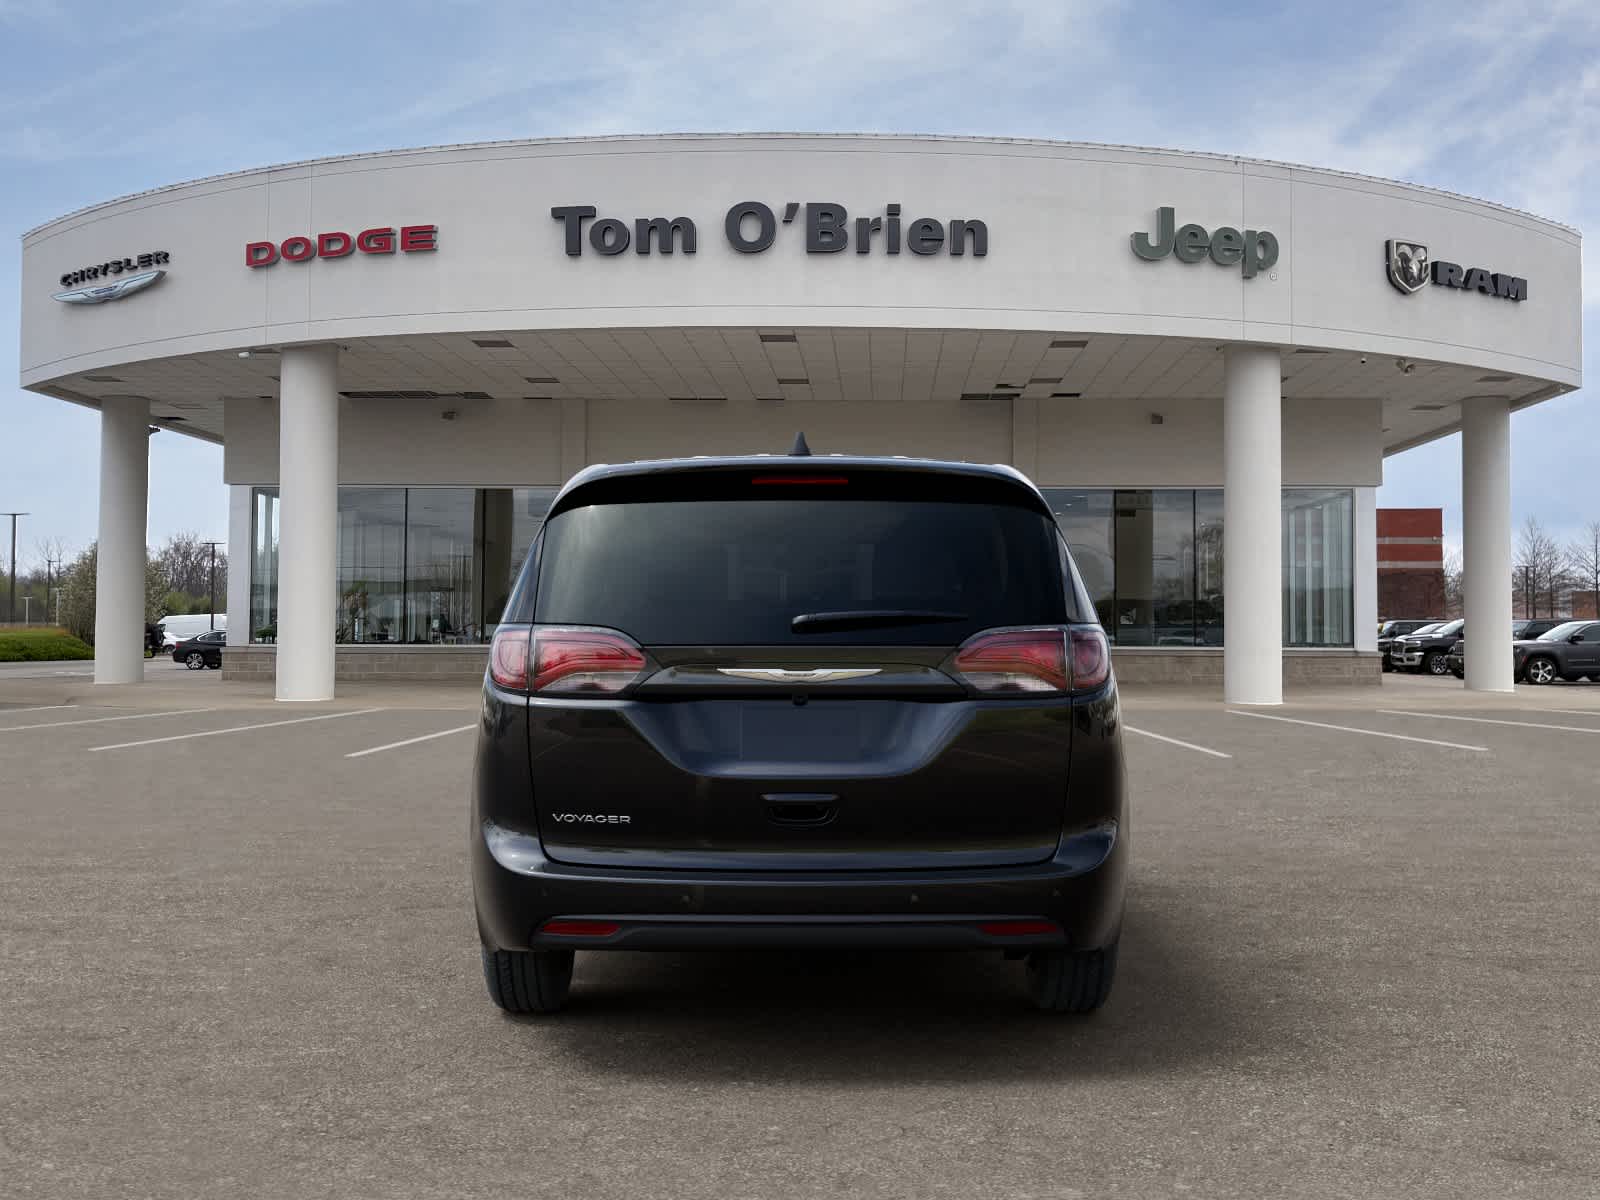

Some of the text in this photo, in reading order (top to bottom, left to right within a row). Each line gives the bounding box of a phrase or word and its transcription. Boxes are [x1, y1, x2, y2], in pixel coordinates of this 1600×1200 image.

[246, 225, 438, 268] DODGE
[551, 201, 989, 256] Tom O'Brien
[1130, 206, 1279, 279] Jeep
[60, 251, 170, 287] CHRYSLER
[1431, 260, 1528, 302] RAM
[552, 813, 631, 824] VOYAGER
